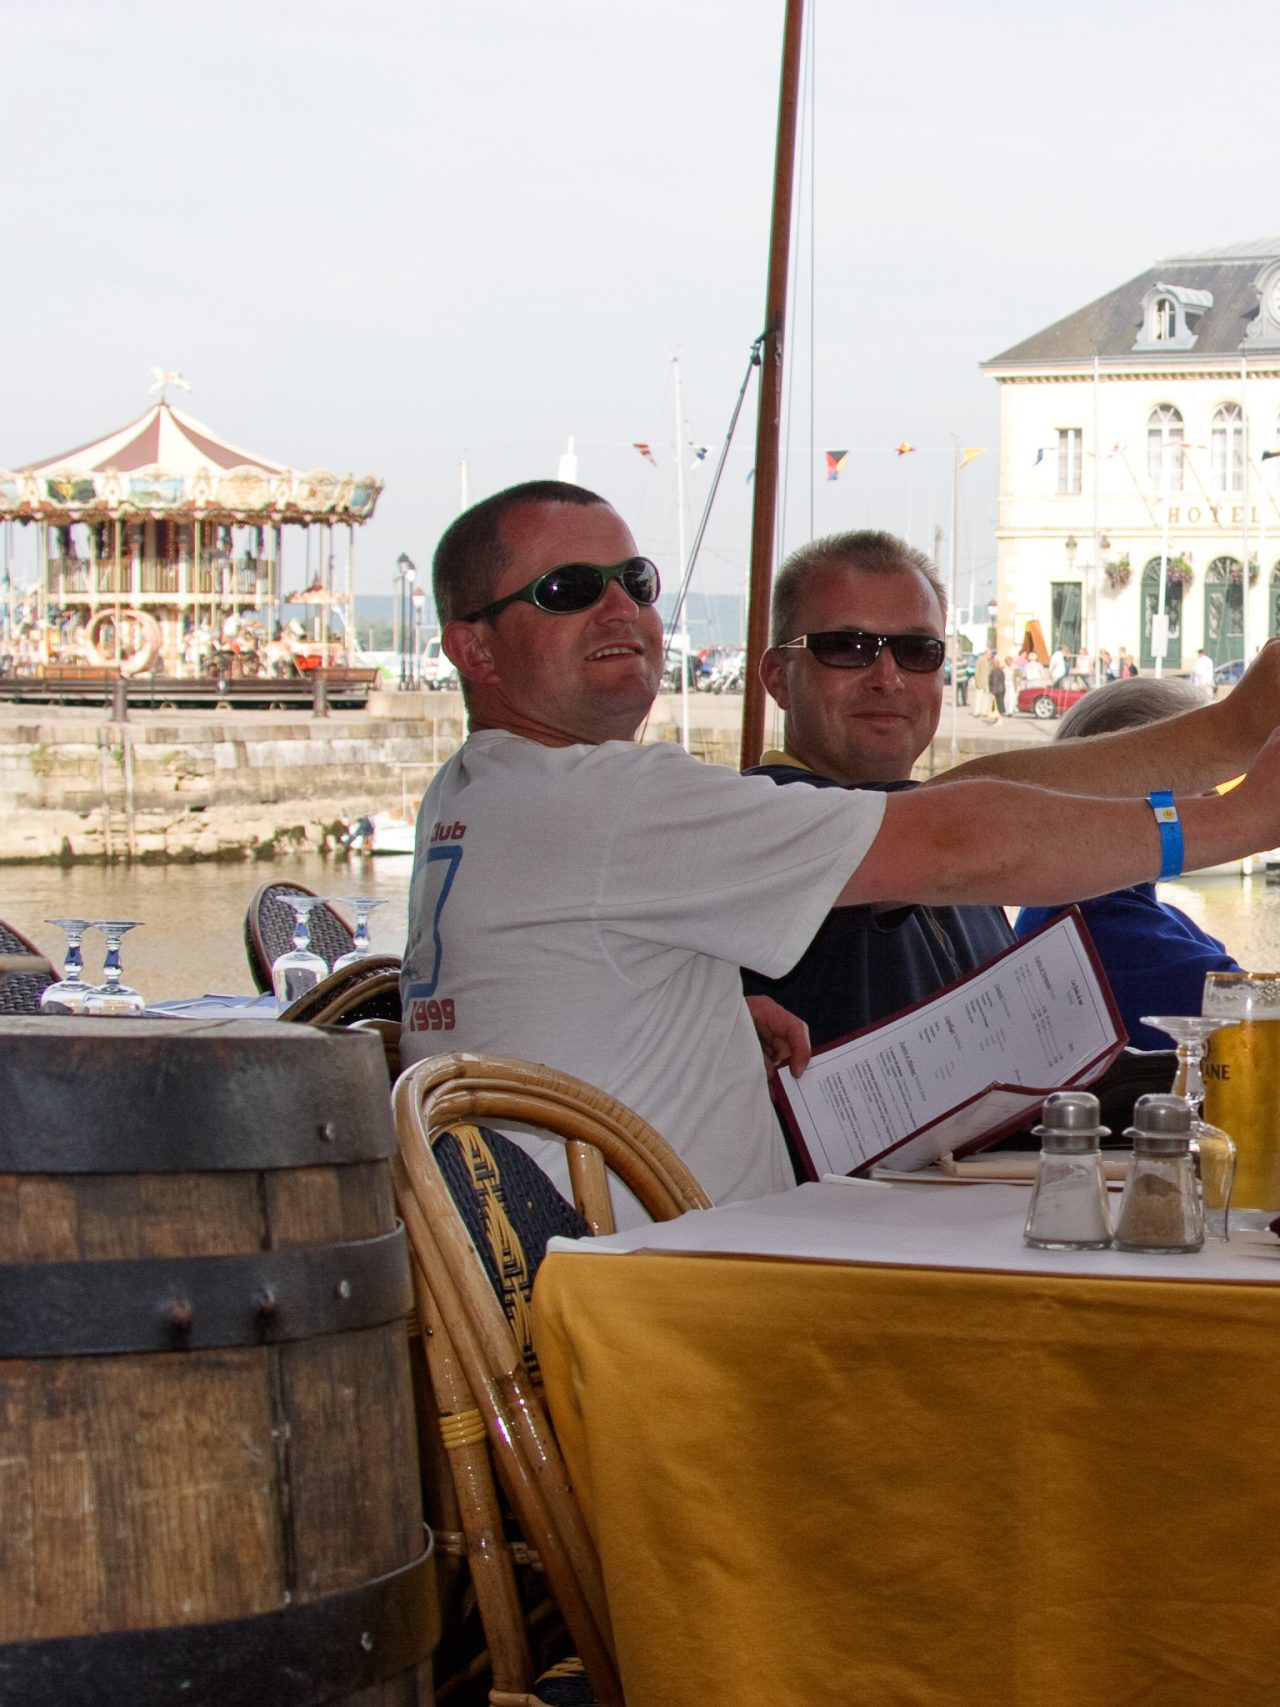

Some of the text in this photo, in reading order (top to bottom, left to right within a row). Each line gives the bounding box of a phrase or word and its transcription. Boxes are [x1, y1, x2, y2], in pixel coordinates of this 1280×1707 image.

[1167, 506, 1261, 523] HOTEL
[429, 821, 467, 842] lub
[409, 998, 456, 1032] 1999
